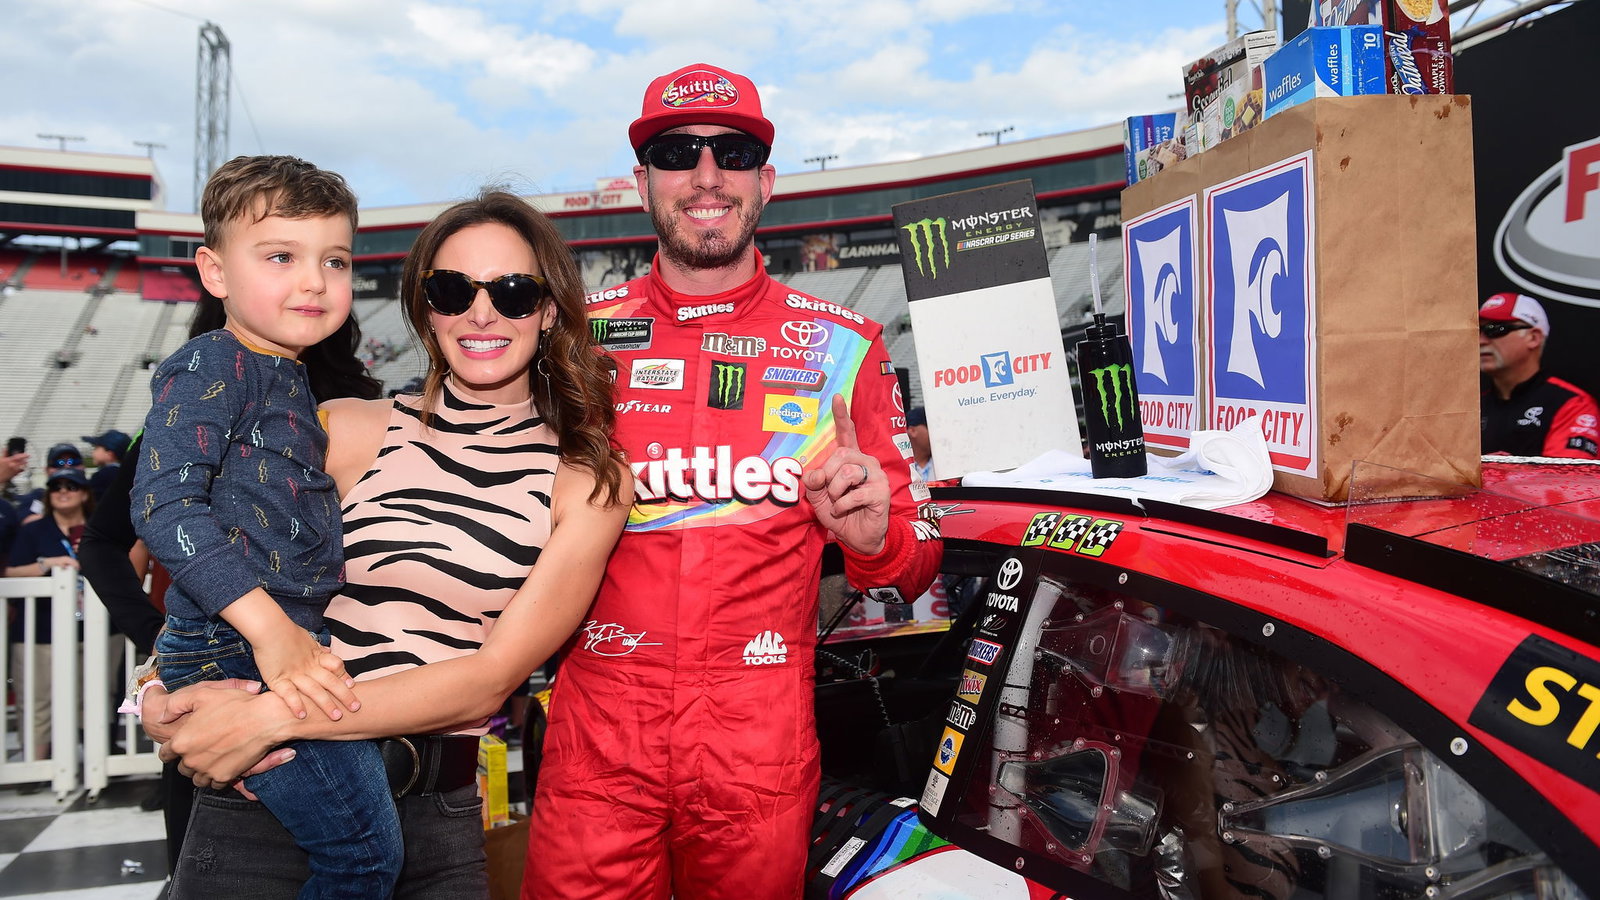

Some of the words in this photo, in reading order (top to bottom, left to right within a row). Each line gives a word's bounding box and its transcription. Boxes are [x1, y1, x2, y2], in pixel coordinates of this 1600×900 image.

[1363, 33, 1377, 50] 10
[1327, 43, 1339, 86] waffles
[1431, 62, 1439, 89] MAPLE
[1438, 70, 1446, 95] ROWN
[667, 79, 735, 102] Skittles
[1268, 72, 1302, 103] waffles
[1161, 126, 1171, 142] fru
[601, 193, 622, 206] CITY
[951, 206, 1034, 231] MONSTER
[965, 222, 1023, 237] ENERGY
[966, 237, 995, 249] NASCAR
[995, 233, 1010, 244] CUP
[1009, 229, 1036, 240] SERIES
[838, 243, 900, 259] EARNHA
[677, 302, 735, 322] Skittles
[785, 293, 865, 325] Skittles
[608, 320, 648, 328] MONSTER
[770, 346, 835, 365] TOYOTA
[764, 367, 820, 384] SNICKERS
[934, 364, 982, 388] FOOD
[1012, 352, 1052, 374] CITY
[957, 395, 987, 408] Value.
[990, 387, 1037, 402] Everyday.
[769, 407, 813, 420] Pedigree
[1166, 401, 1193, 430] CITY
[1261, 408, 1304, 447] CITY
[631, 445, 803, 507] kittles
[985, 592, 1019, 613] TOYOTA
[742, 630, 788, 657] MAC
[742, 654, 788, 666] TOOLS
